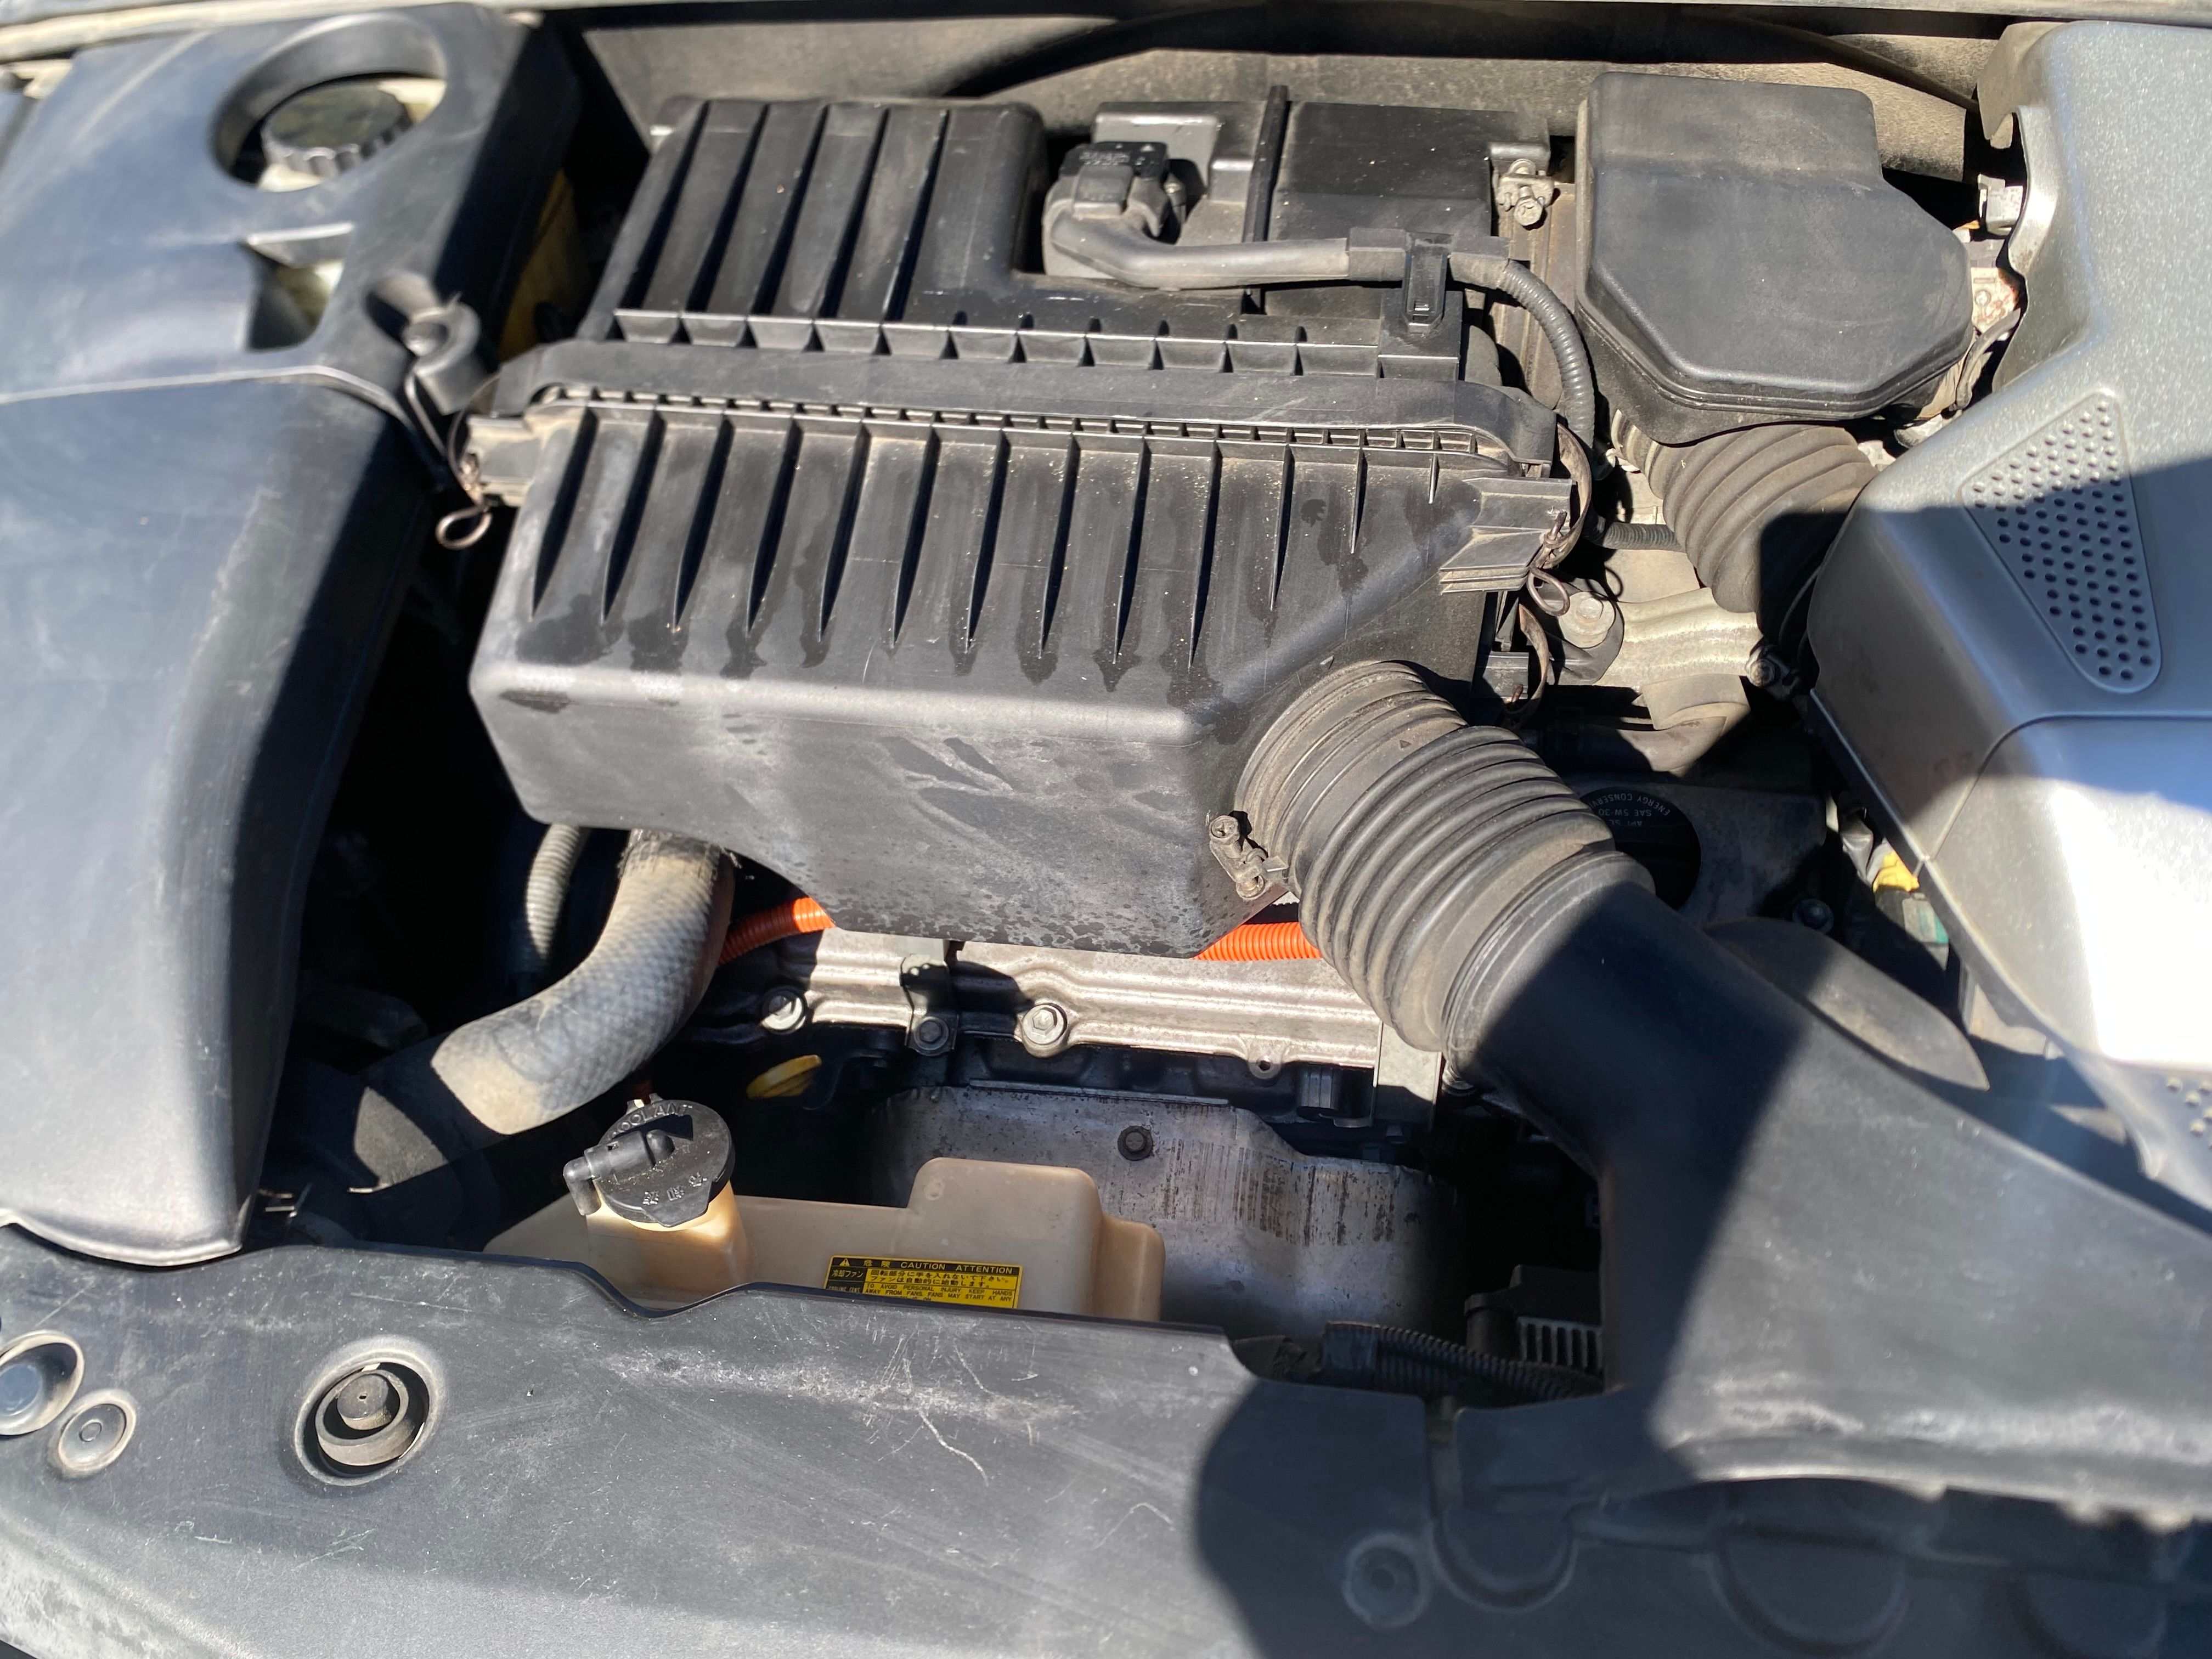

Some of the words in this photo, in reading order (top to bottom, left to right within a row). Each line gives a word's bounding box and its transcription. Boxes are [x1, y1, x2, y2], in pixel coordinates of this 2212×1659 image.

[1637, 795, 1671, 816] ENERGY
[832, 1269, 864, 1278] 冷却ファン
[900, 1261, 946, 1270] CAUTION
[956, 1264, 1013, 1274] ATTENTION
